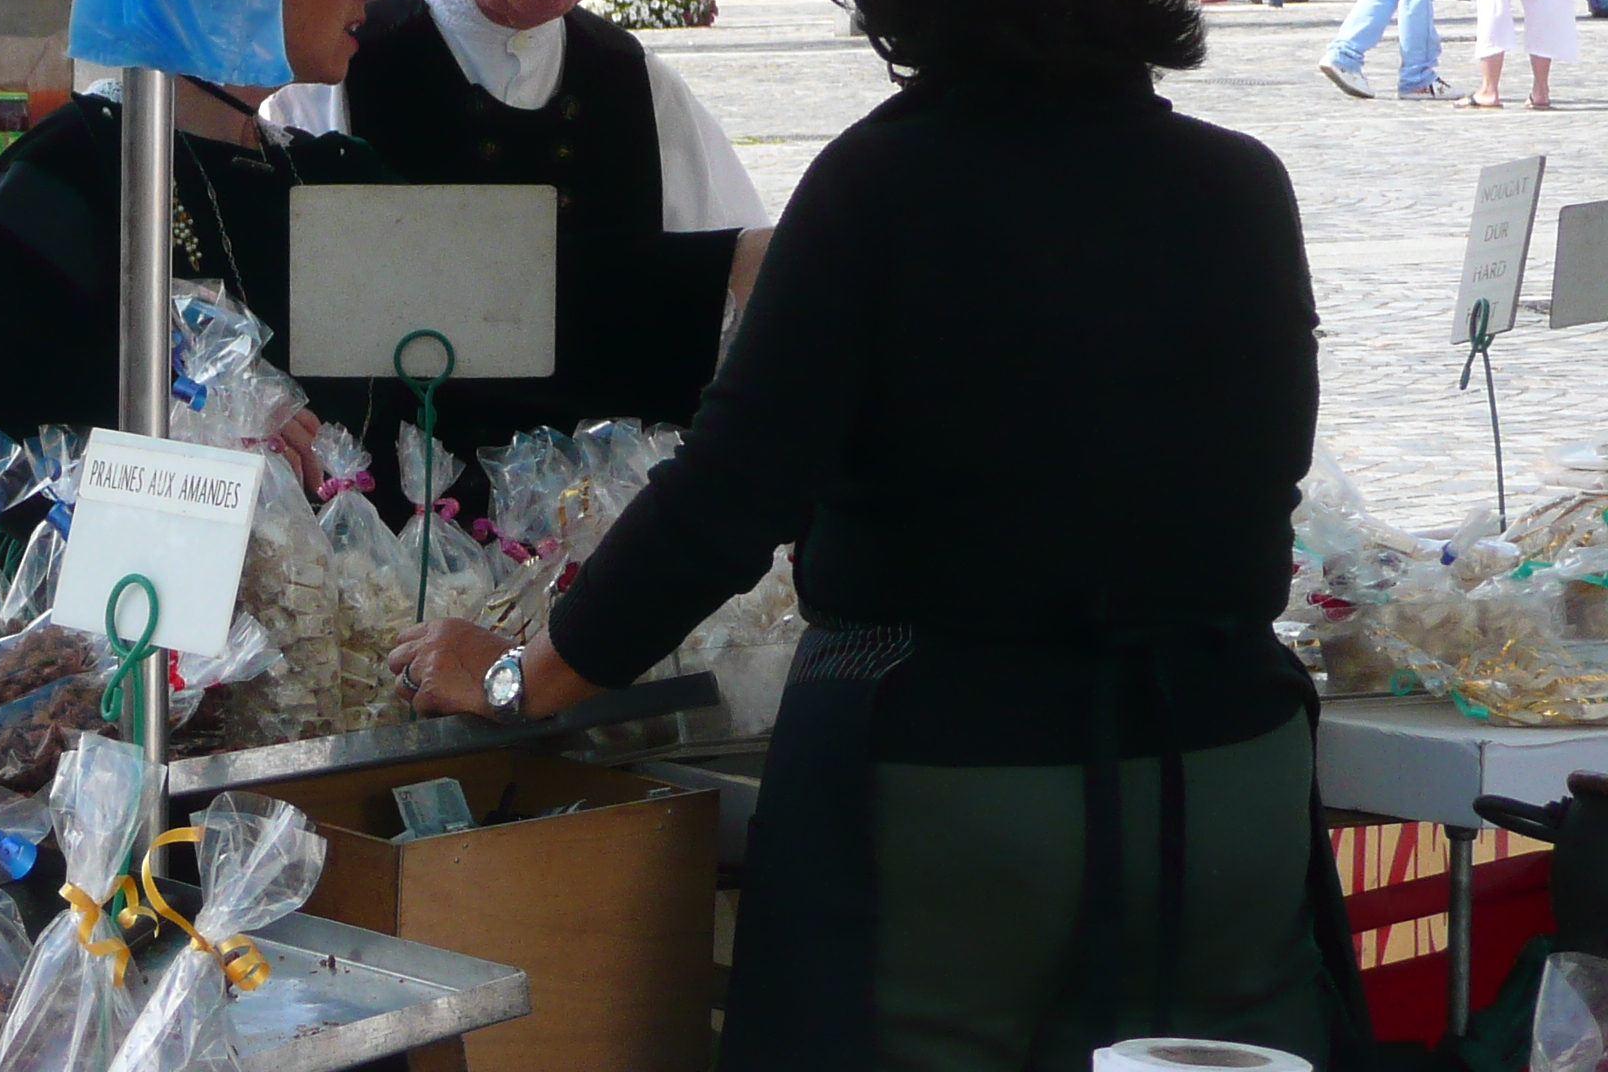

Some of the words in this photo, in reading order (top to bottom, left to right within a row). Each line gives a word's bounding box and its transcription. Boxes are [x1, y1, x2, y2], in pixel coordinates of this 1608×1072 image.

[1481, 176, 1530, 203] NOUGAT
[1484, 221, 1510, 243] DUR
[1472, 259, 1507, 284] HARD
[89, 459, 145, 493] PRALINES
[147, 469, 176, 499] AUX
[178, 474, 242, 510] AMANDES
